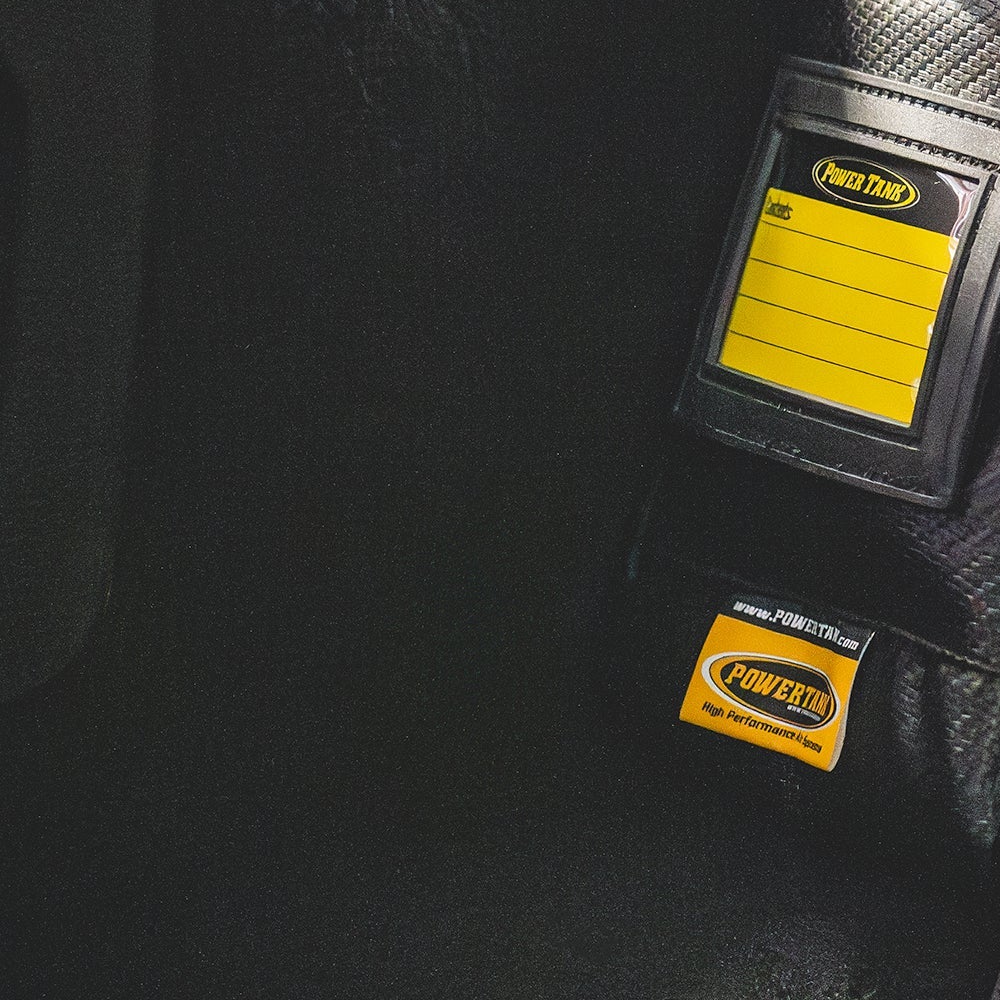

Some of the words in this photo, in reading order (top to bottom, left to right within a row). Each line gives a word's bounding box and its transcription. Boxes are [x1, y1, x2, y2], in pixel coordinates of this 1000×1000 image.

[821, 161, 866, 192] POWER
[862, 173, 907, 203] TANK
[701, 701, 725, 718] High
[726, 710, 796, 740] Performance
